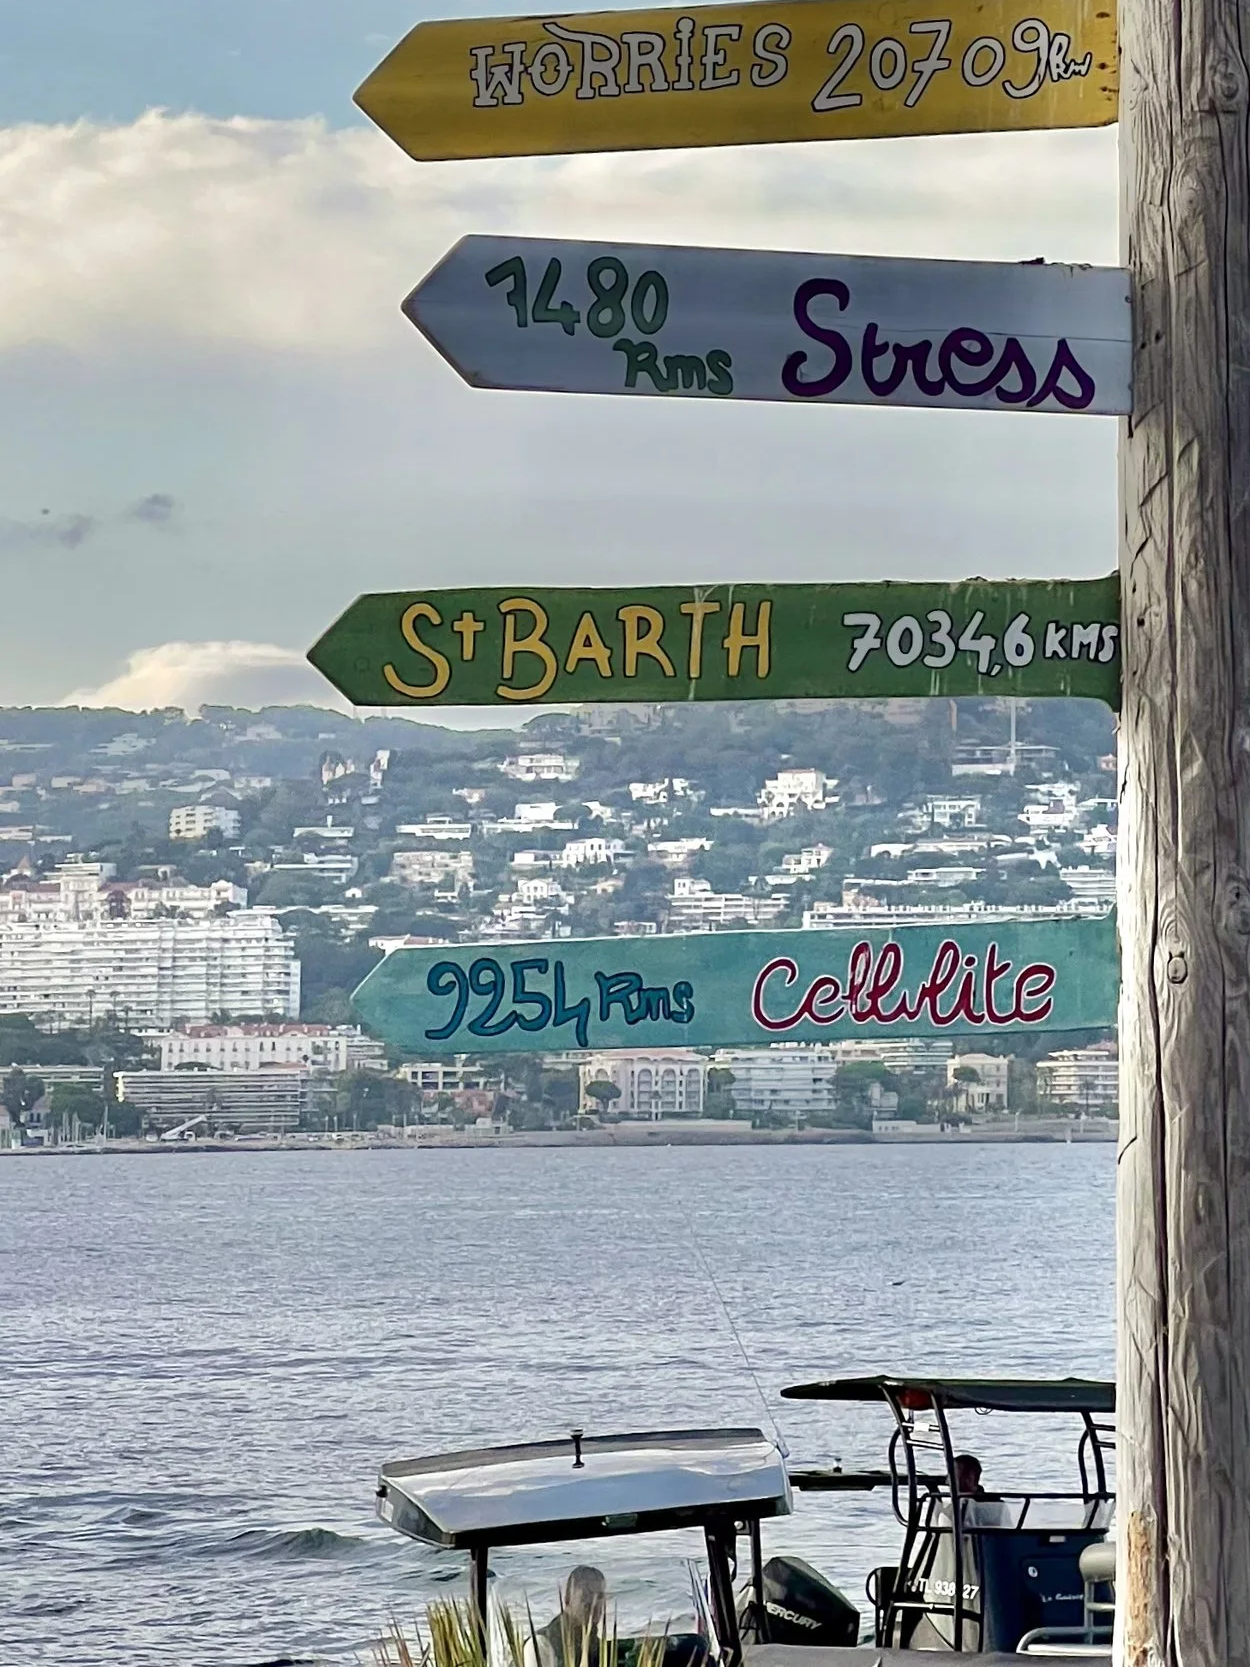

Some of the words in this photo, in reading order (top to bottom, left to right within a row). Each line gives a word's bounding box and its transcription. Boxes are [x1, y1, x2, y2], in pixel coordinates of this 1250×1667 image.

[484, 255, 671, 338] 1480
[781, 277, 1097, 410] Stress
[495, 597, 774, 702] BARTH
[752, 939, 1056, 1031] Cellulite
